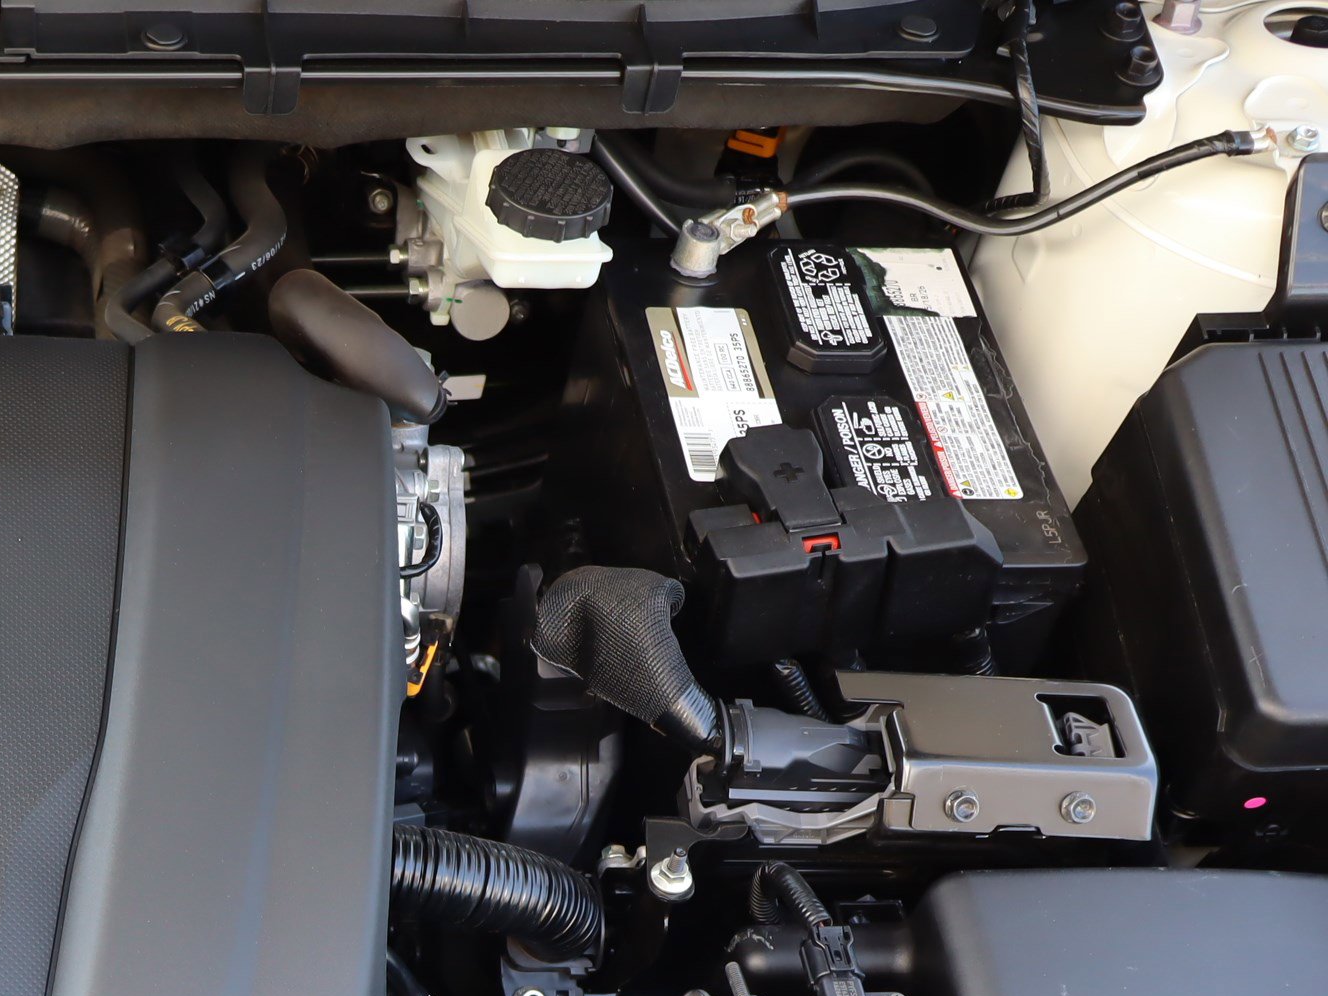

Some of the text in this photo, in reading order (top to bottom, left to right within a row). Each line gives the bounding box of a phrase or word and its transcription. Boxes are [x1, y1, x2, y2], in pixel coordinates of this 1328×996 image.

[658, 330, 686, 388] ACDelco
[729, 333, 754, 391] 88865270 35PS
[832, 409, 854, 445] POISON
[883, 447, 894, 456] NO
[848, 454, 871, 491] ANGER
